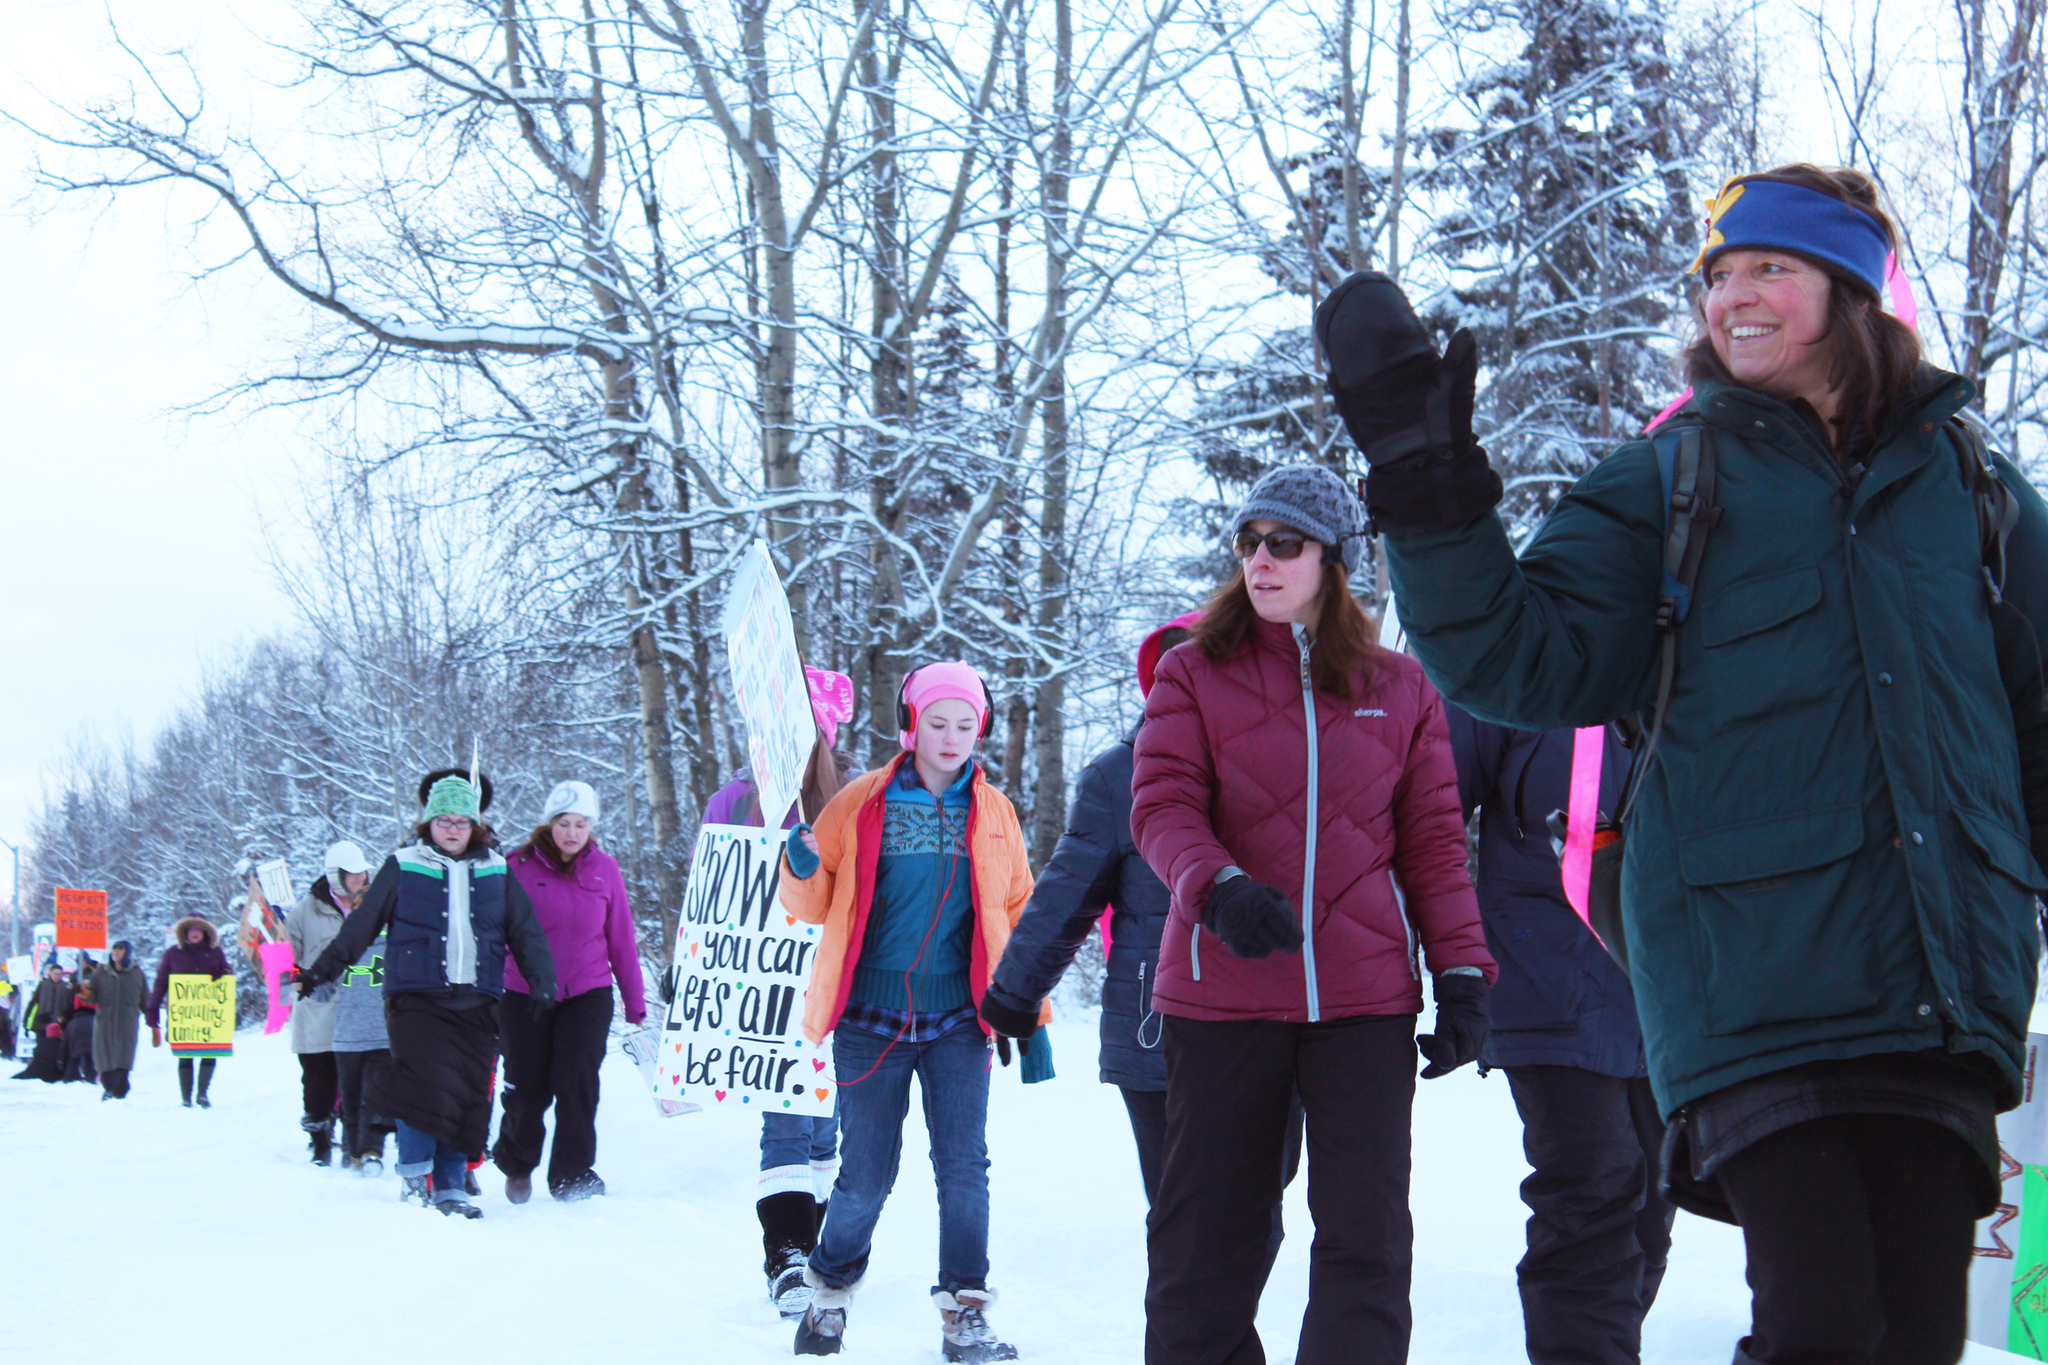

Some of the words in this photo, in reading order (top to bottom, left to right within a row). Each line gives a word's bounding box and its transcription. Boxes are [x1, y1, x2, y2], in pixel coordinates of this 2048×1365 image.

[59, 893, 106, 905] RESPECT
[61, 919, 104, 930] PERIOD
[703, 931, 752, 973] you
[757, 937, 819, 976] car
[666, 965, 730, 1031] Let's
[738, 984, 796, 1036] all
[685, 1043, 722, 1086] be
[724, 1045, 804, 1094] fair.
